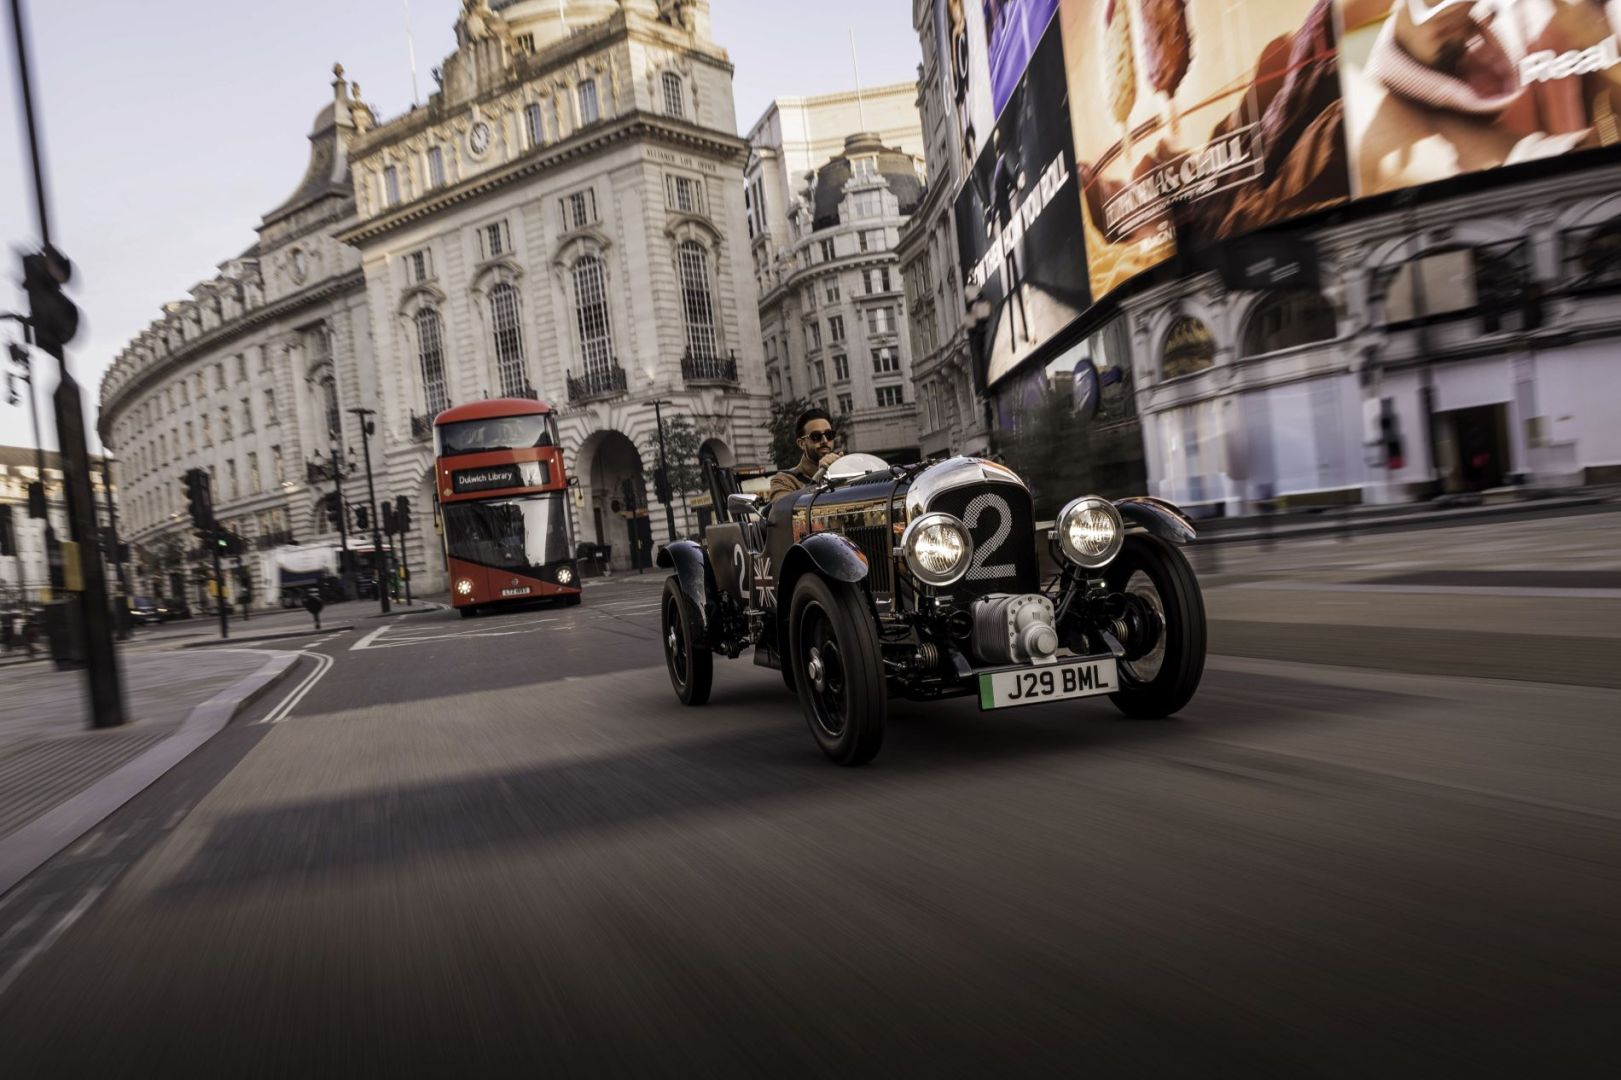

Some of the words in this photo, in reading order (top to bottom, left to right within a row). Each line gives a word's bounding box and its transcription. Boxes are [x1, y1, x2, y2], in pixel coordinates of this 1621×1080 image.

[1179, 135, 1250, 184] CHILL
[1020, 181, 1042, 232] YOU
[1040, 150, 1070, 210] ROLL
[458, 474, 487, 485] Dulwich
[488, 472, 513, 482] Library
[963, 493, 1016, 580] 2
[734, 543, 750, 599] 2
[1008, 671, 1055, 700] J29
[1061, 665, 1109, 693] BML
